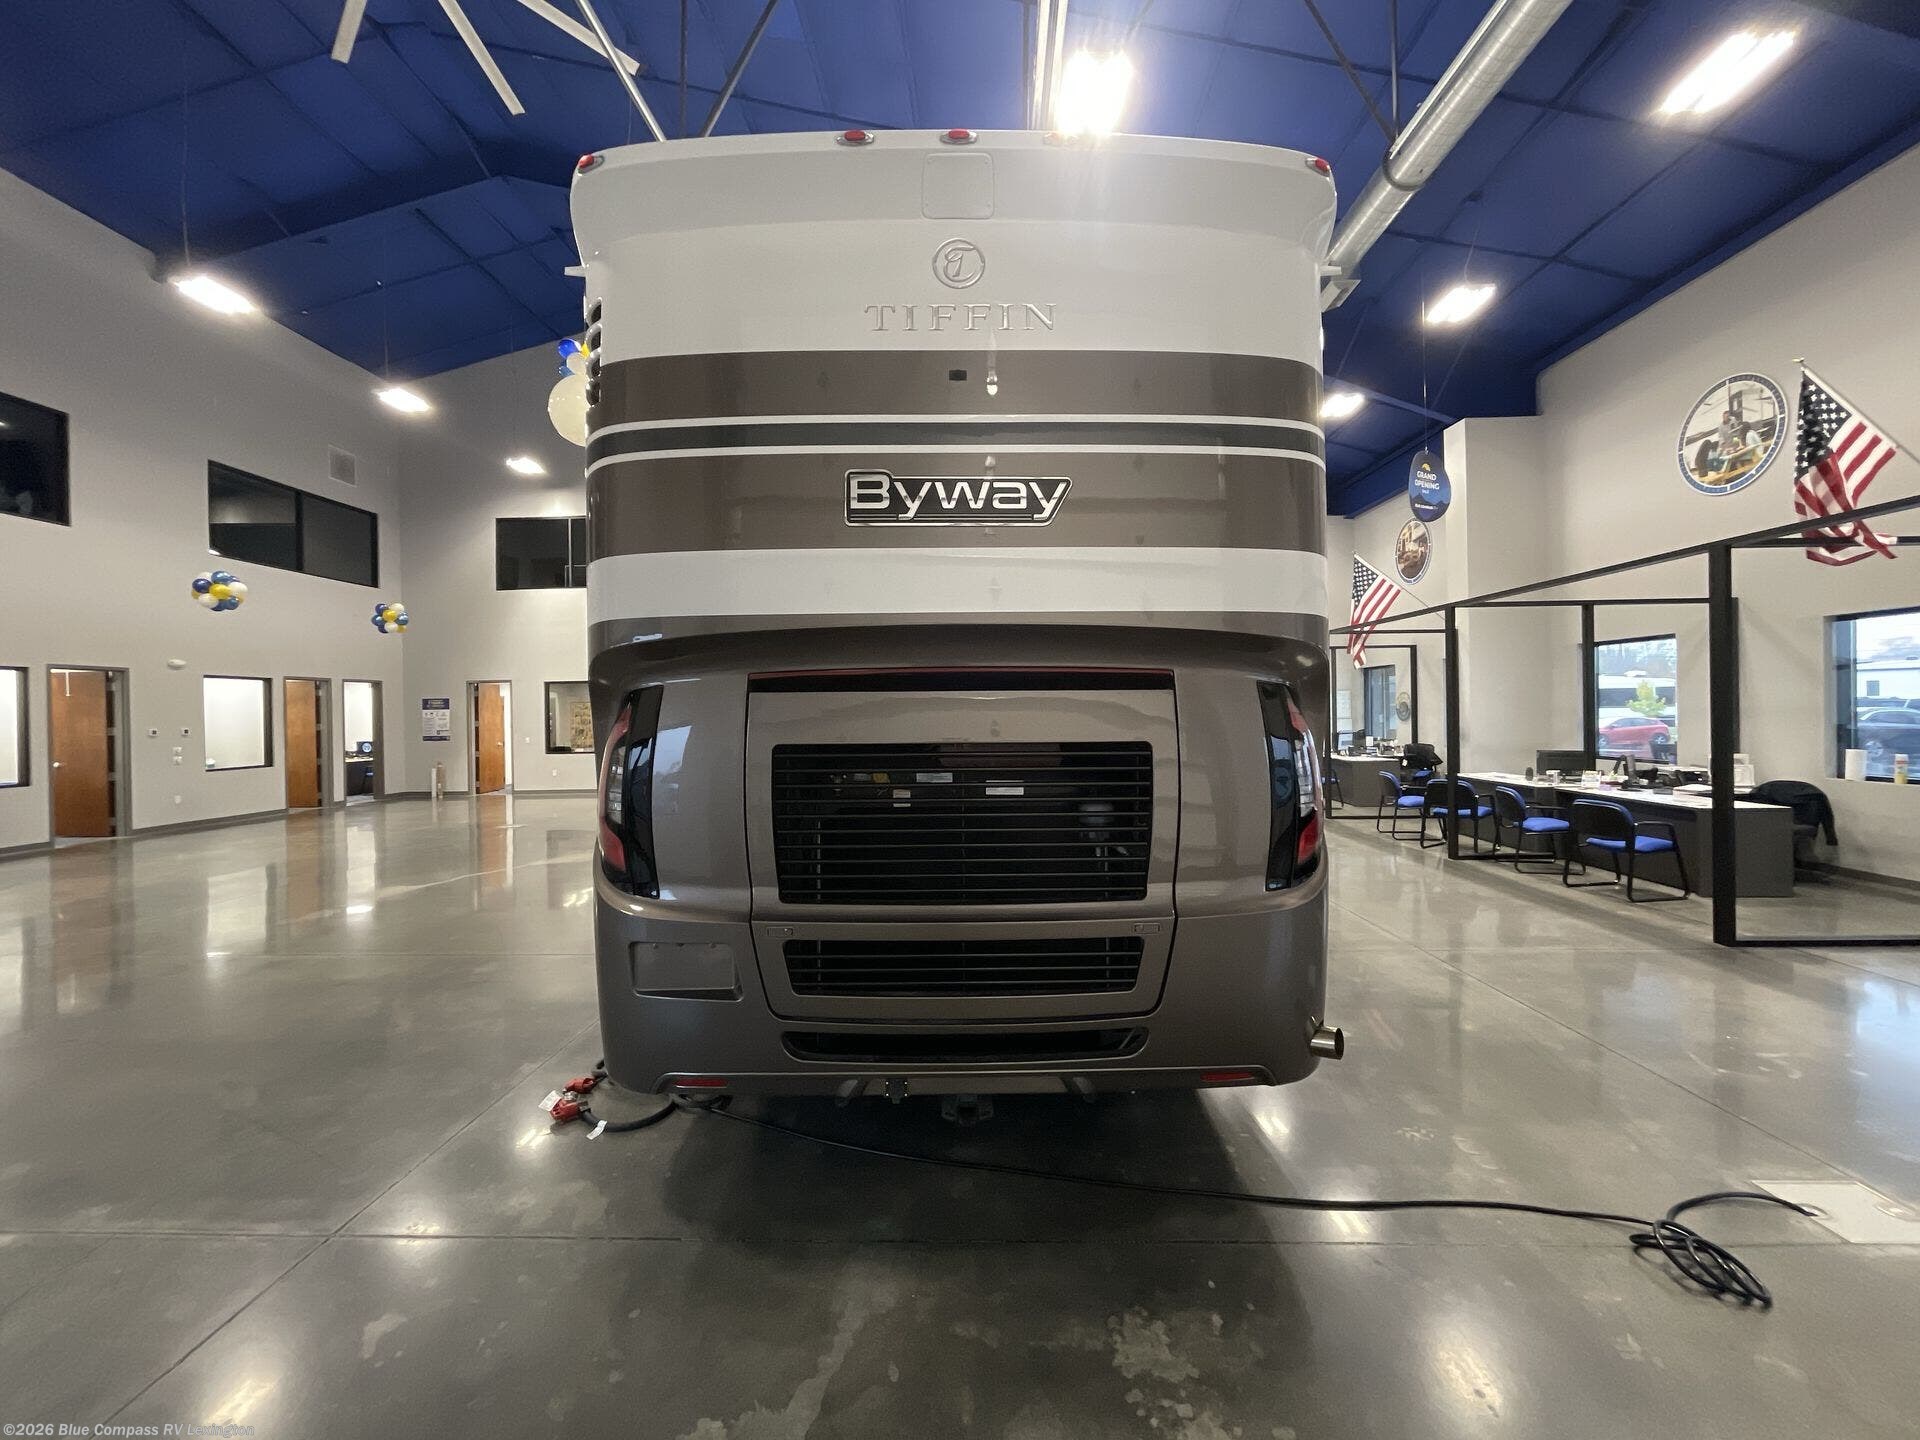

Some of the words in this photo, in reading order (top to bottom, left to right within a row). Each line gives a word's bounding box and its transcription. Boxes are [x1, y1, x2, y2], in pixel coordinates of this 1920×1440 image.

[864, 303, 1057, 332] TIFFIN
[1414, 479, 1440, 490] OPENING
[1416, 470, 1437, 481] GRAND
[850, 475, 1067, 520] Byway
